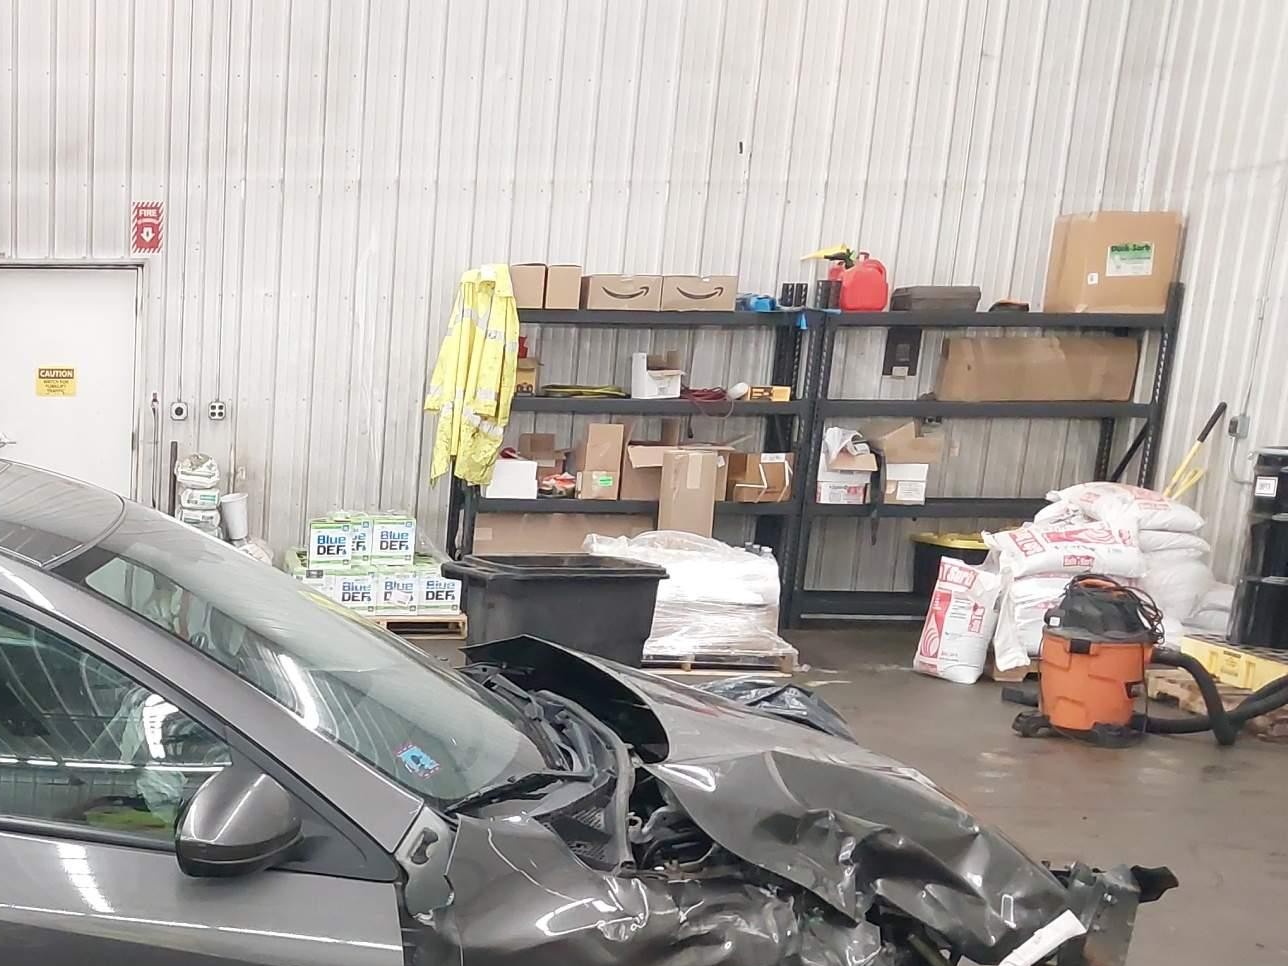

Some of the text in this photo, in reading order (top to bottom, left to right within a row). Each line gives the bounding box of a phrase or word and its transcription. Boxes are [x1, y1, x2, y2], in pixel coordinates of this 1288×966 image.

[139, 209, 158, 217] FIRE
[40, 370, 73, 378] CAUTION
[317, 535, 347, 545] Blue
[380, 530, 409, 540] Blue
[317, 545, 346, 555] DEF
[380, 541, 408, 550] DEF
[342, 581, 371, 592] Blue
[384, 580, 413, 591] Blue
[426, 580, 455, 590] Blue
[341, 592, 370, 602] DEF
[425, 590, 454, 601] DEF
